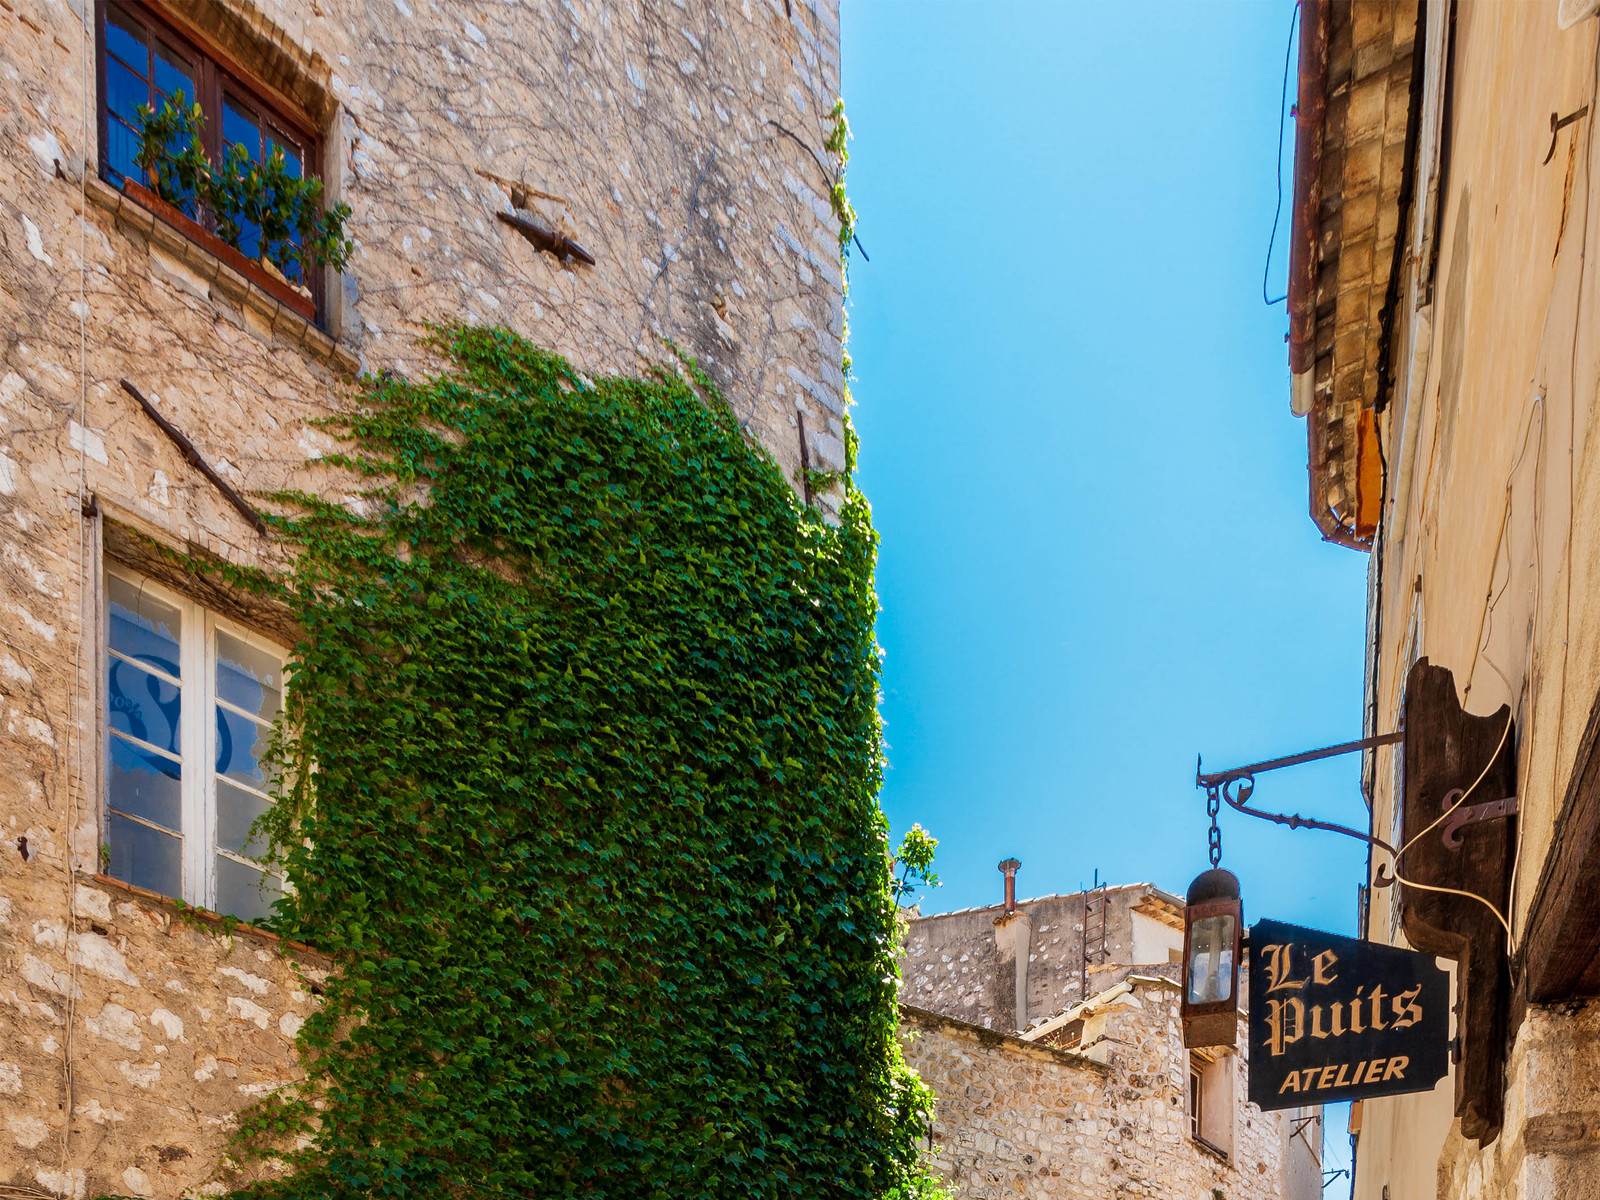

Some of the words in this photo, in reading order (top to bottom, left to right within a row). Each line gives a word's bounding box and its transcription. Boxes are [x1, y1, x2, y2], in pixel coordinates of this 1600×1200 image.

[1260, 943, 1338, 993] Le
[1262, 983, 1423, 1056] Puits
[1278, 1055, 1409, 1095] ATELIER
